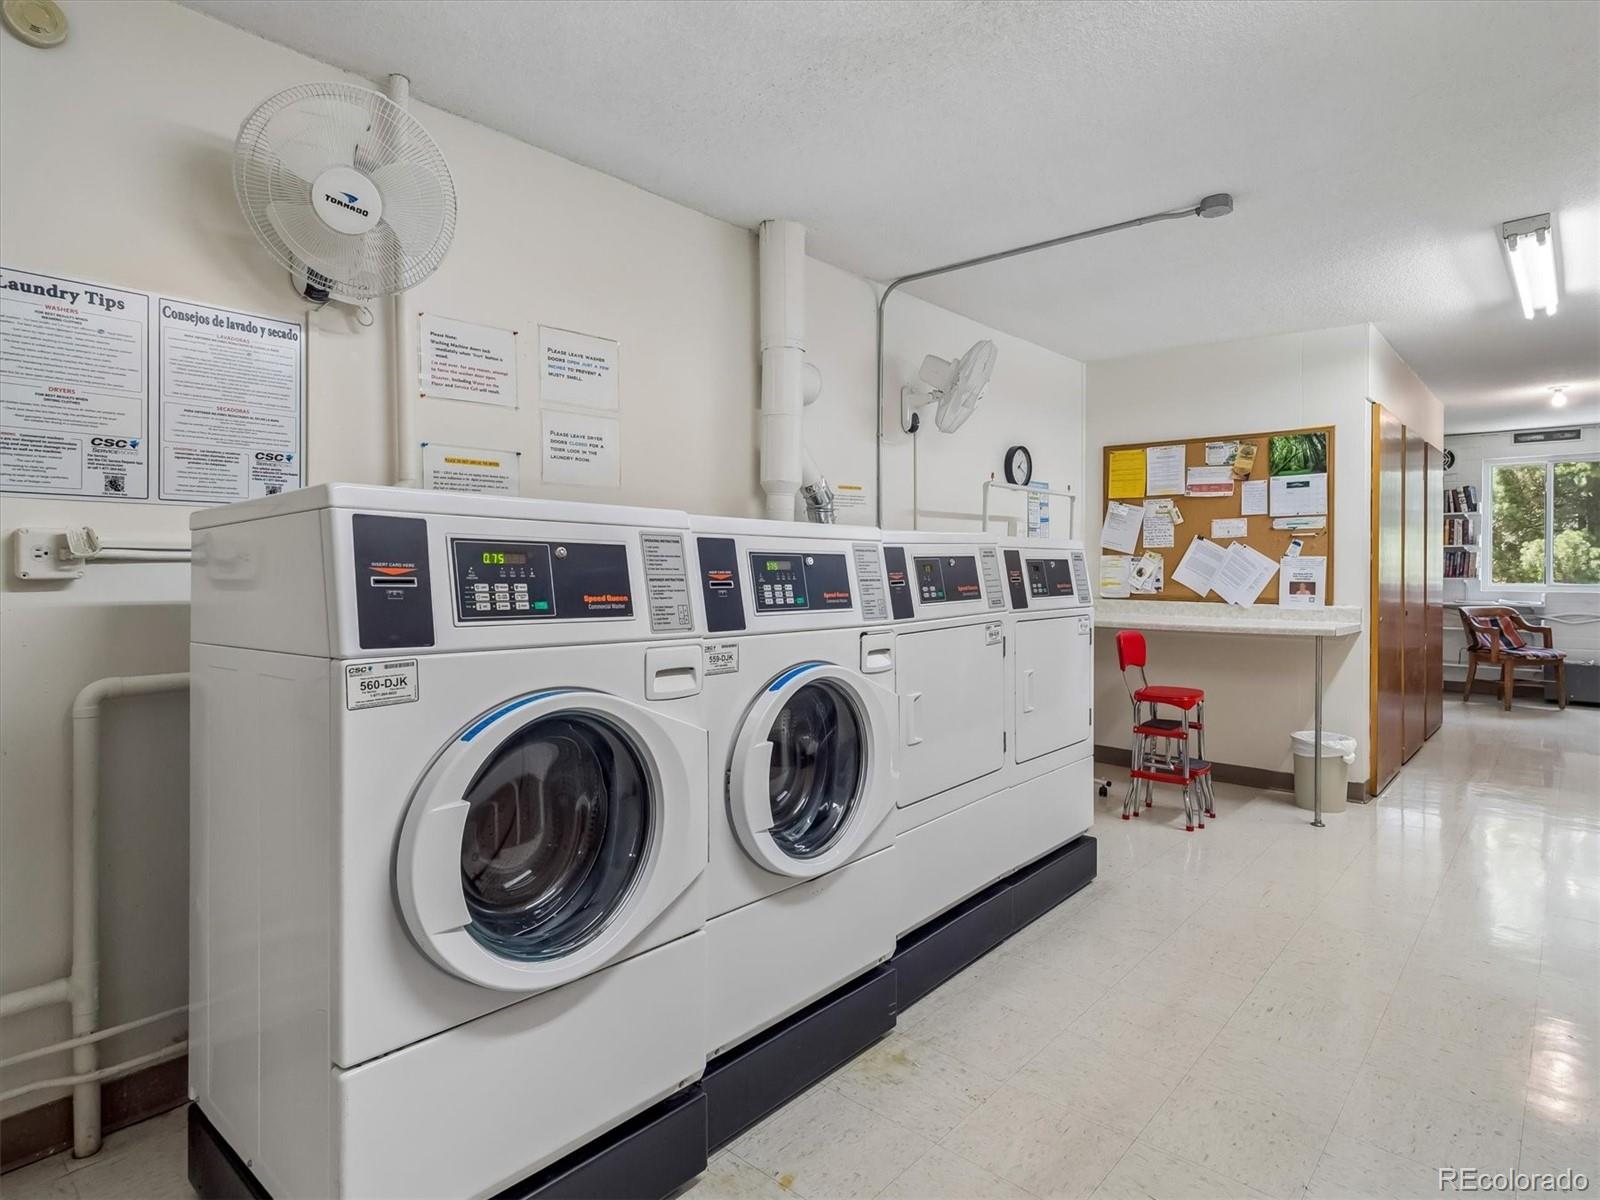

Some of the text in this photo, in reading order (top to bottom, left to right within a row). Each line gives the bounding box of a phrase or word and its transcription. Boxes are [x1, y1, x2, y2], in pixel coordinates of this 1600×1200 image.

[325, 194, 369, 217] TORNADO
[84, 290, 125, 312] Tips
[44, 304, 79, 314] WASHERS
[162, 305, 298, 341] Consejos de lavado y secado
[547, 347, 566, 356] PLEASE
[48, 386, 76, 394] DRYERS
[216, 406, 250, 414] SECADORAS
[550, 430, 569, 438] PLEASE
[91, 438, 128, 448] CSC
[255, 452, 284, 462] CSC
[483, 552, 504, 564] 0.75
[584, 594, 606, 602] Speed
[360, 676, 408, 691] 560-DJK
